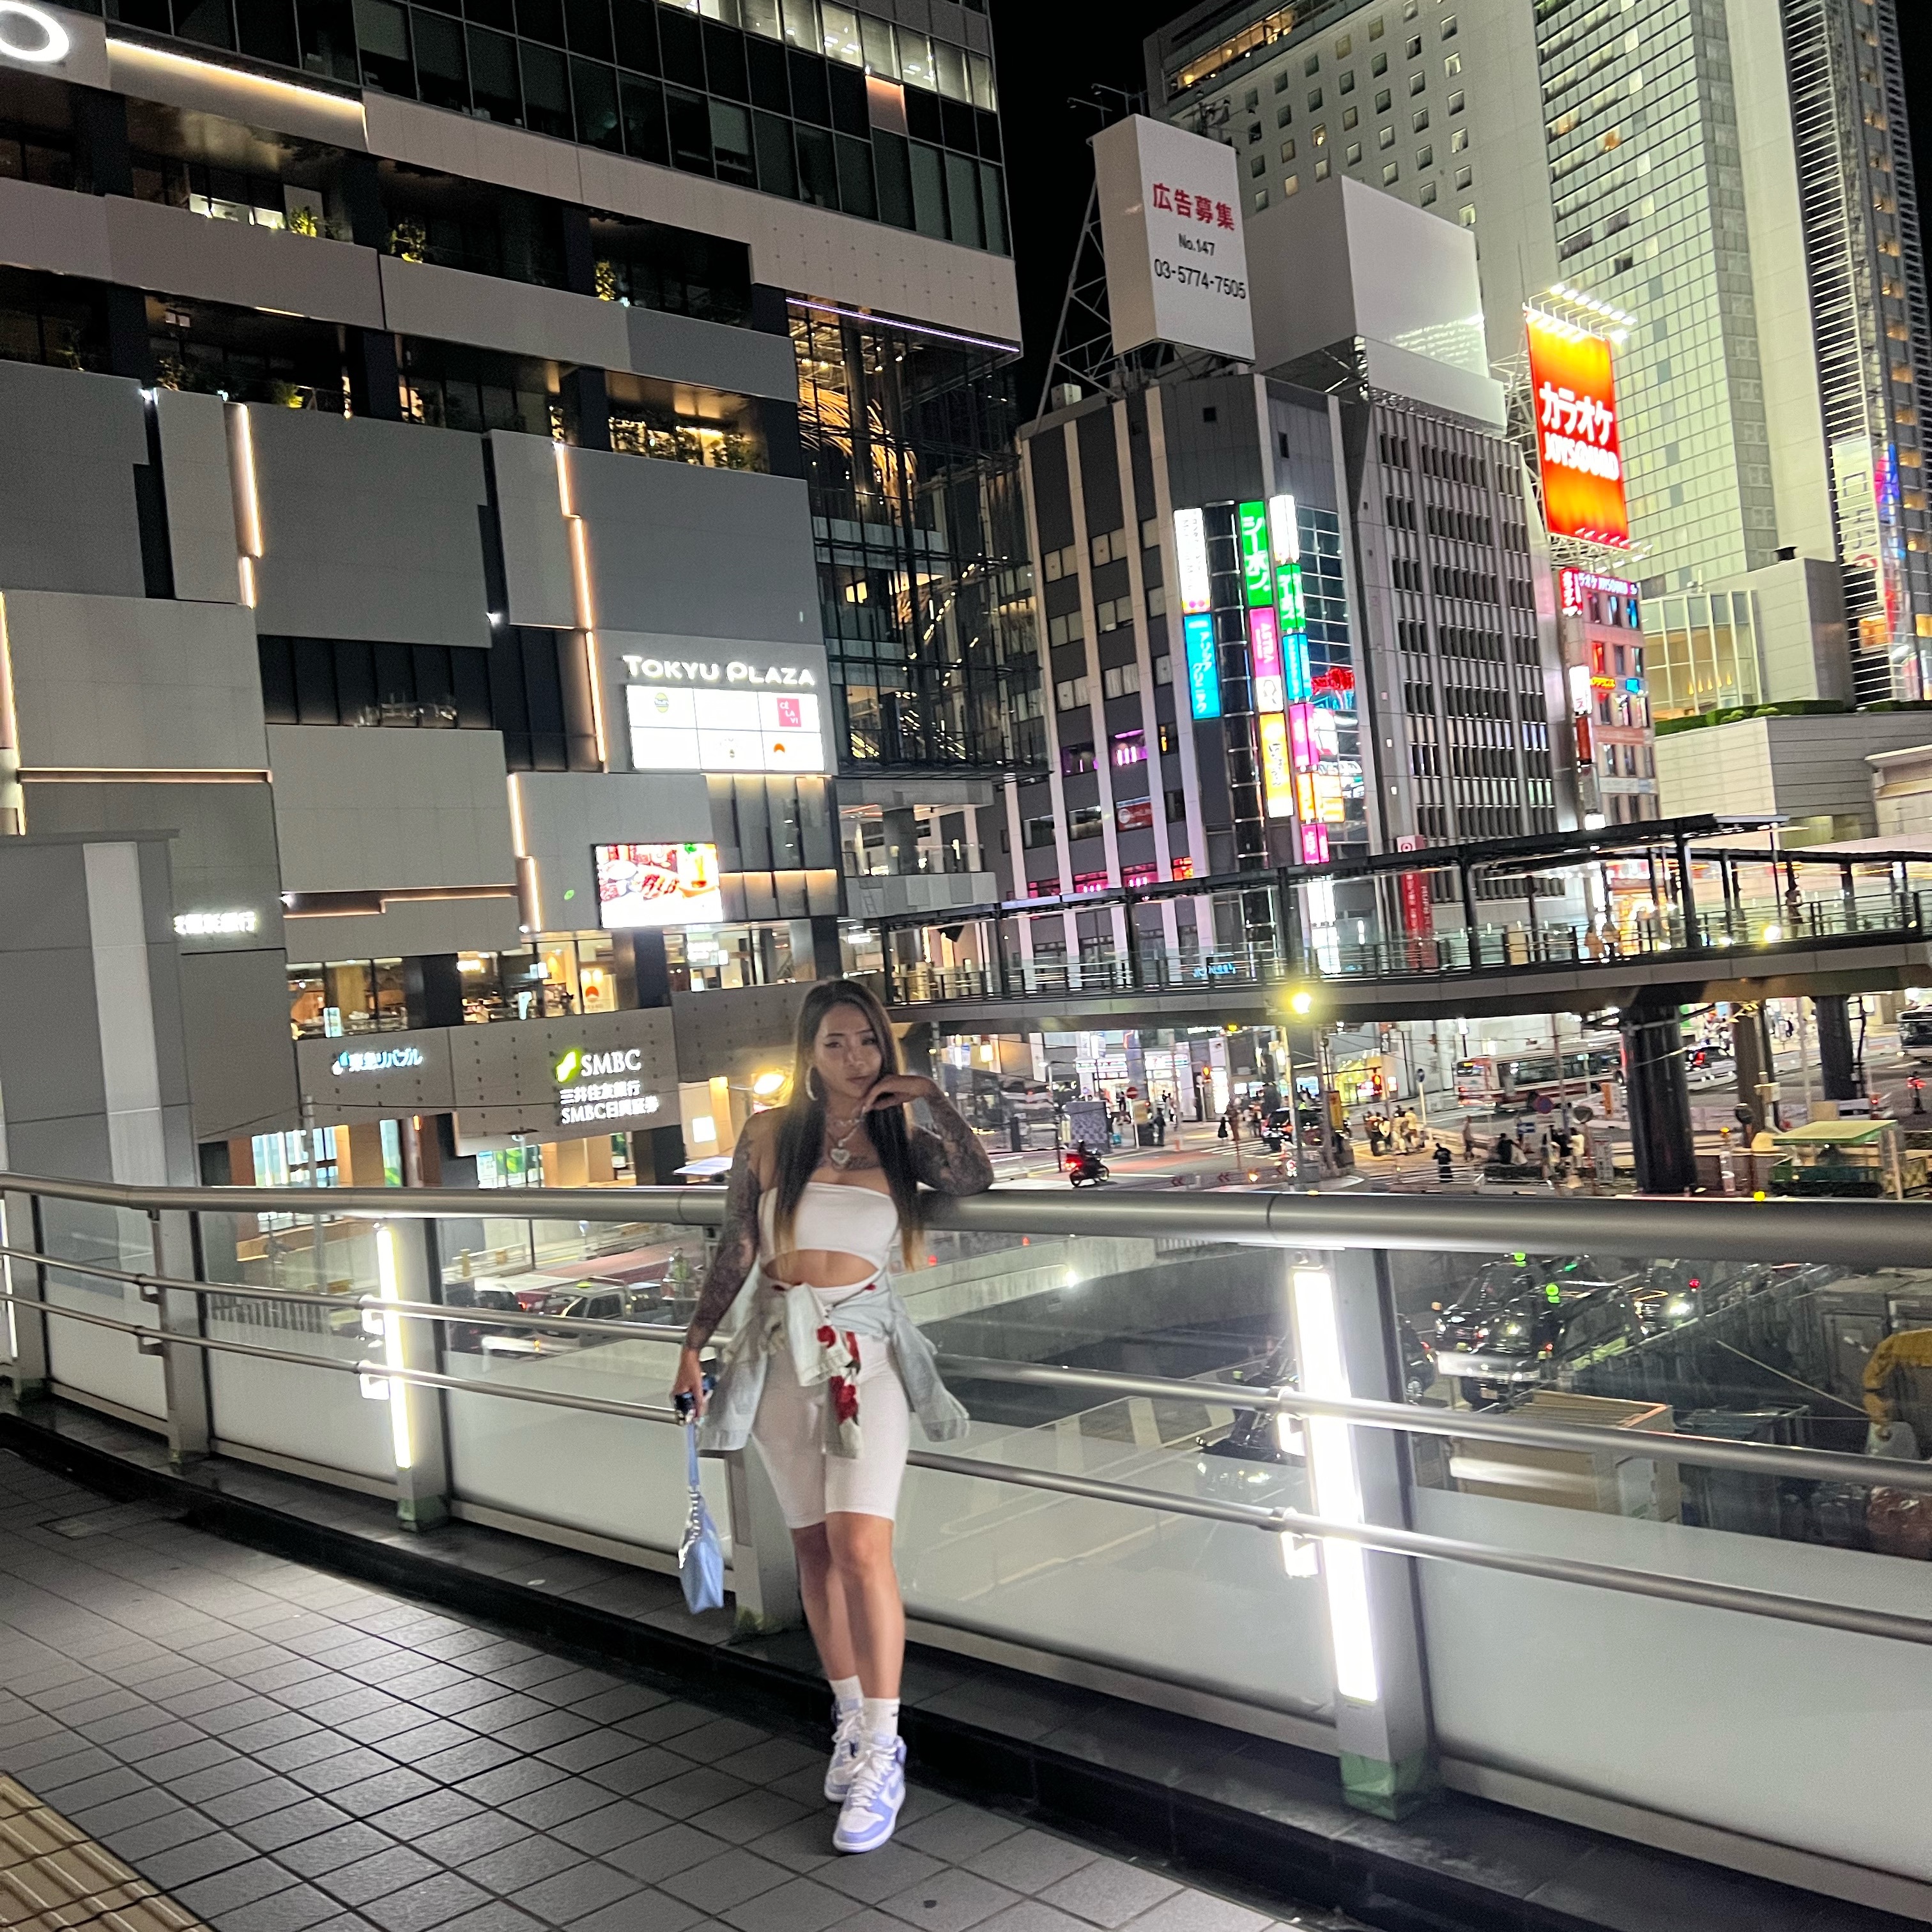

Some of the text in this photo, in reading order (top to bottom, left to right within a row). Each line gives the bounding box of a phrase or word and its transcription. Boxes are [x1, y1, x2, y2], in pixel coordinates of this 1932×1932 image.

[1153, 183, 1234, 231] 広告募集
[1178, 233, 1215, 256] No.147
[1154, 258, 1246, 299] 03-5774-7505
[1539, 381, 1613, 445] カラオケ
[622, 655, 816, 686] TOKYU PLAZA
[581, 1048, 641, 1077] SMBC
